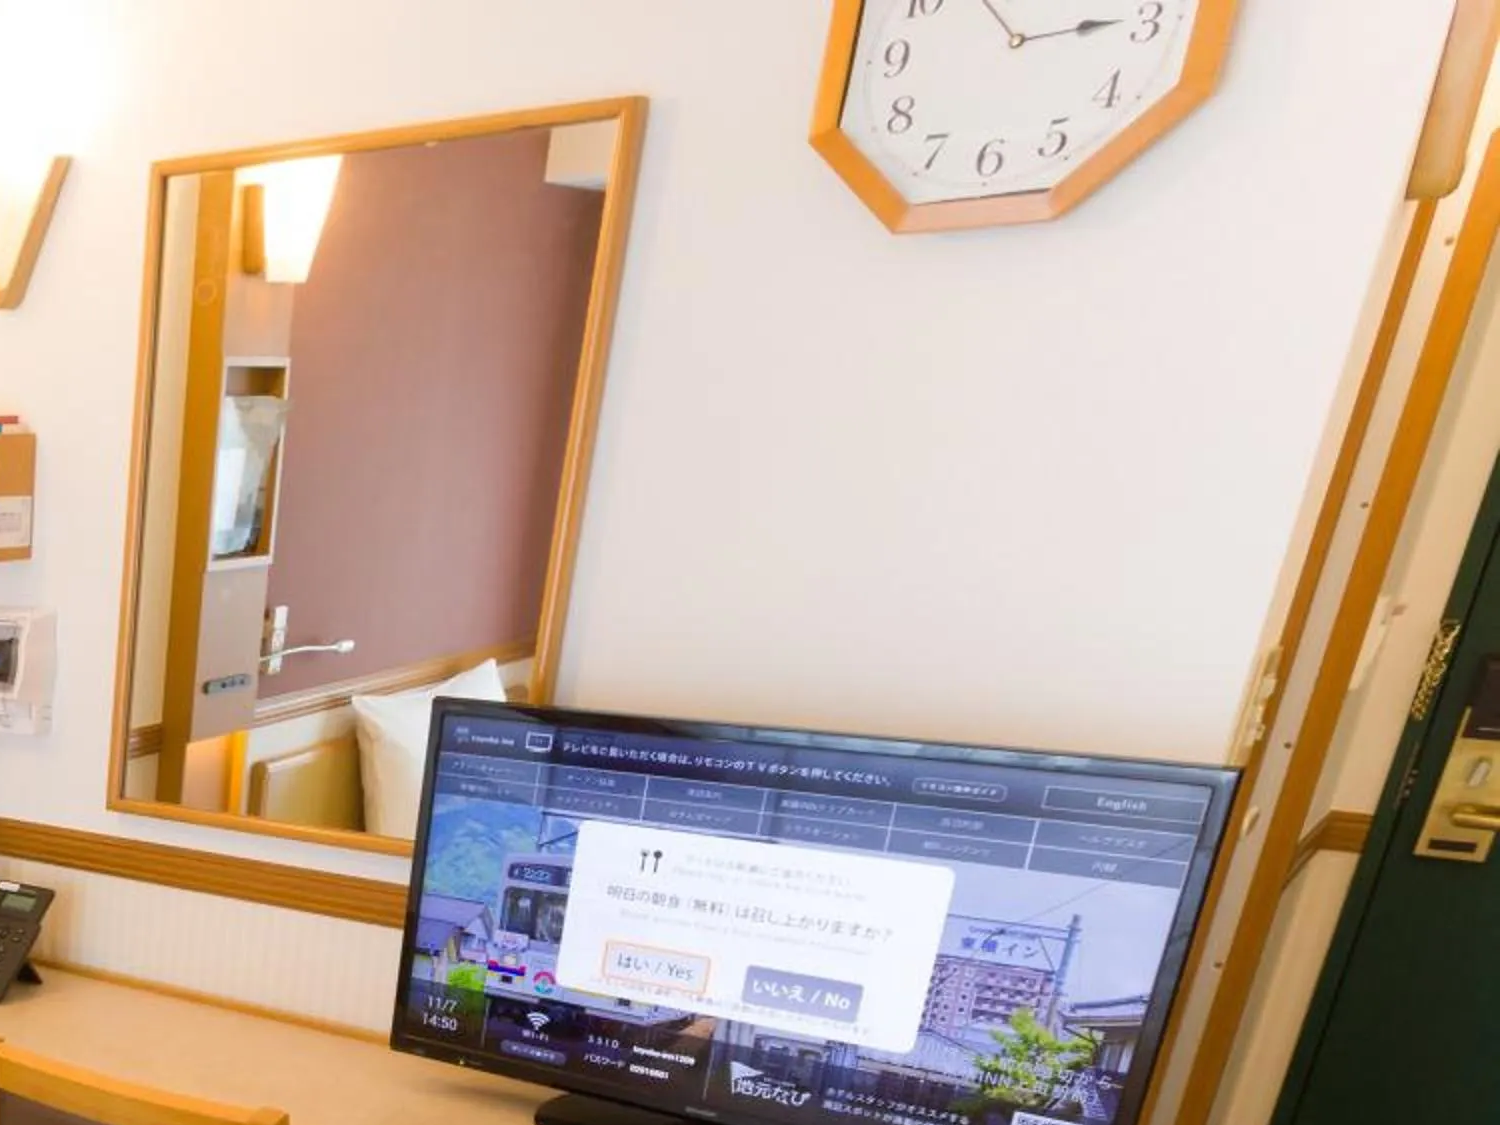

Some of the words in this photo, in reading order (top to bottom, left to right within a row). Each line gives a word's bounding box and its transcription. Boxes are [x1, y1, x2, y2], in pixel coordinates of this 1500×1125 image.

[1129, 2, 1163, 42] 3
[883, 40, 910, 78] 9
[1092, 68, 1121, 109] 4
[887, 95, 914, 134] 8
[923, 134, 949, 171] 7
[1037, 118, 1069, 158] 5
[976, 138, 1005, 176] 6
[1097, 797, 1147, 813] English
[617, 953, 650, 972] はい
[666, 964, 695, 981] Yes
[428, 995, 457, 1013] 11/7
[752, 979, 804, 1002] いいえ
[824, 992, 850, 1010] No
[422, 1013, 457, 1031] 14:50
